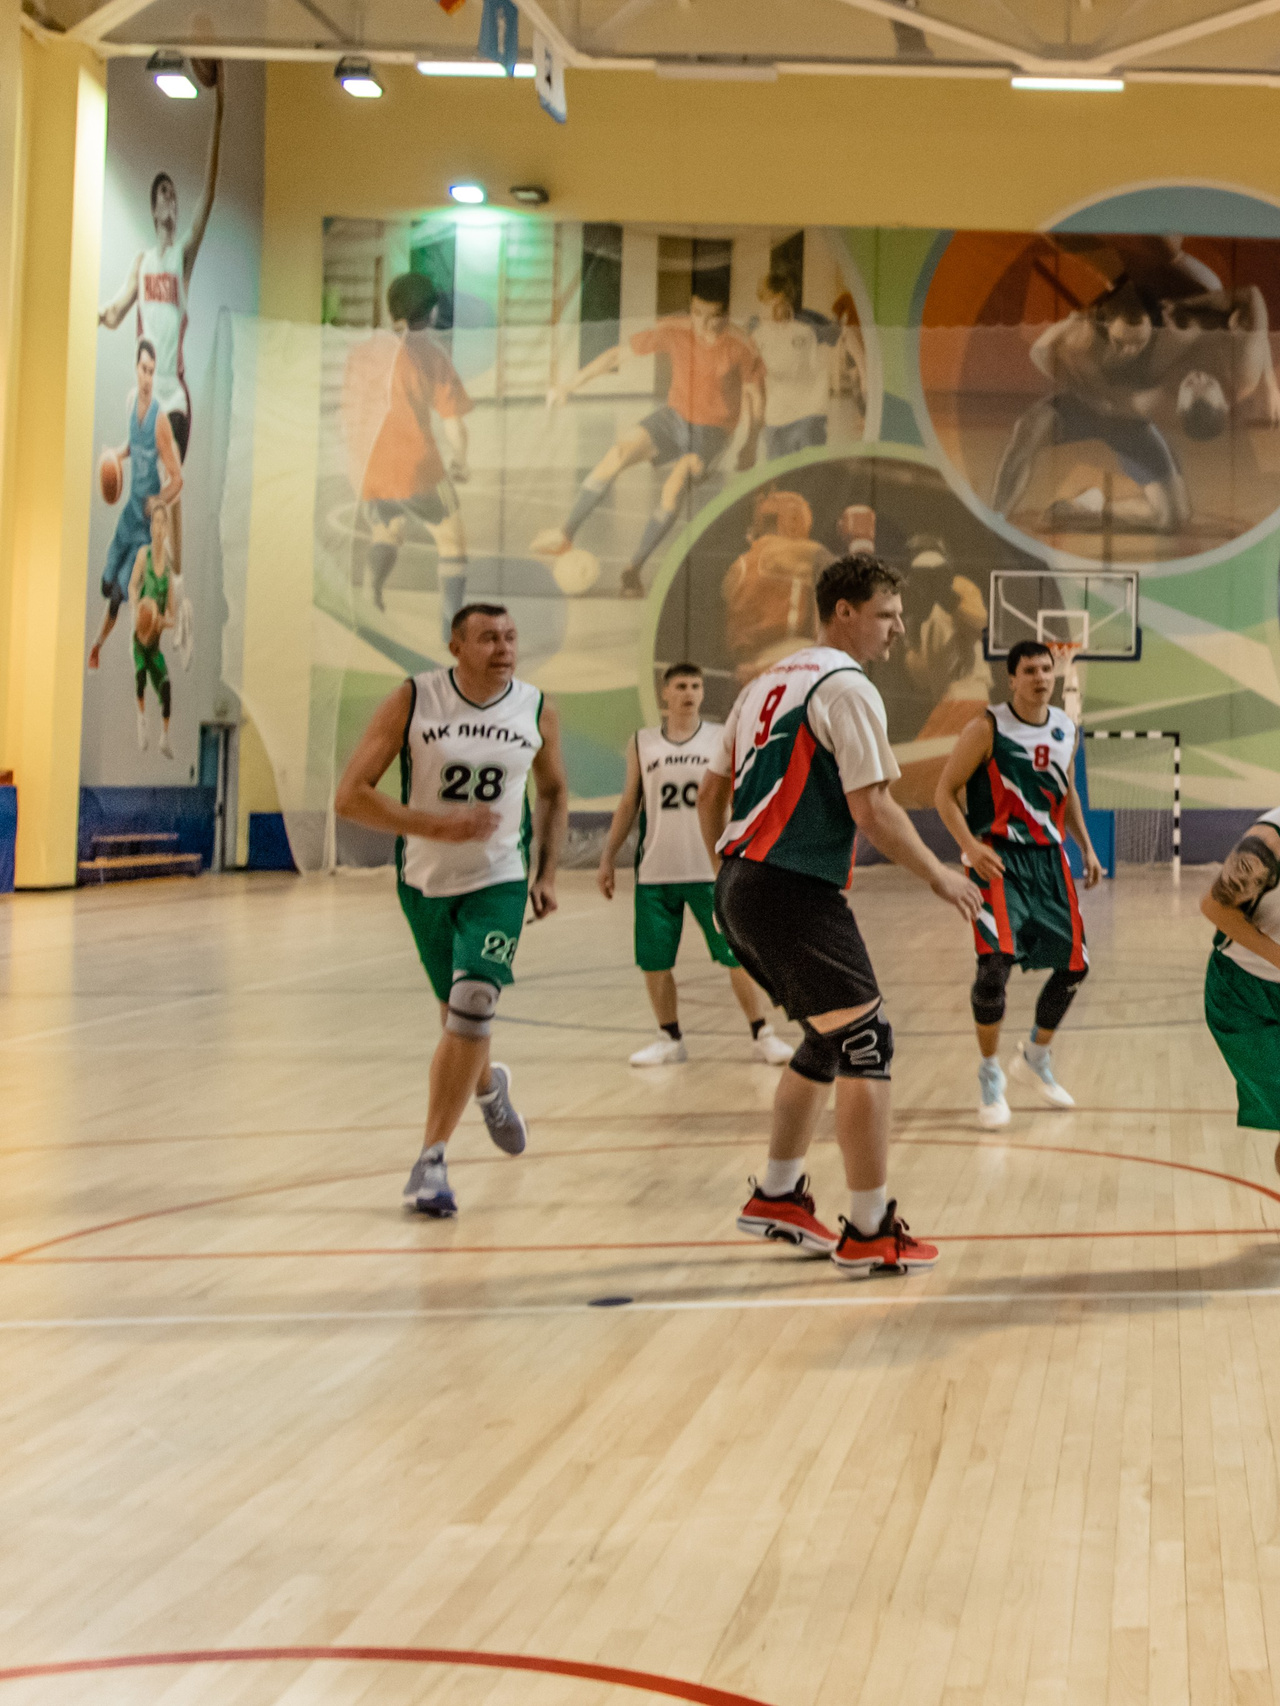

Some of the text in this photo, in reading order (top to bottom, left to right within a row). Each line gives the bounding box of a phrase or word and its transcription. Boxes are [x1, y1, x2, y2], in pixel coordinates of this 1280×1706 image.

[754, 683, 787, 747] 9
[422, 725, 450, 745] НК
[1034, 744, 1049, 769] 8
[440, 763, 505, 803] 28
